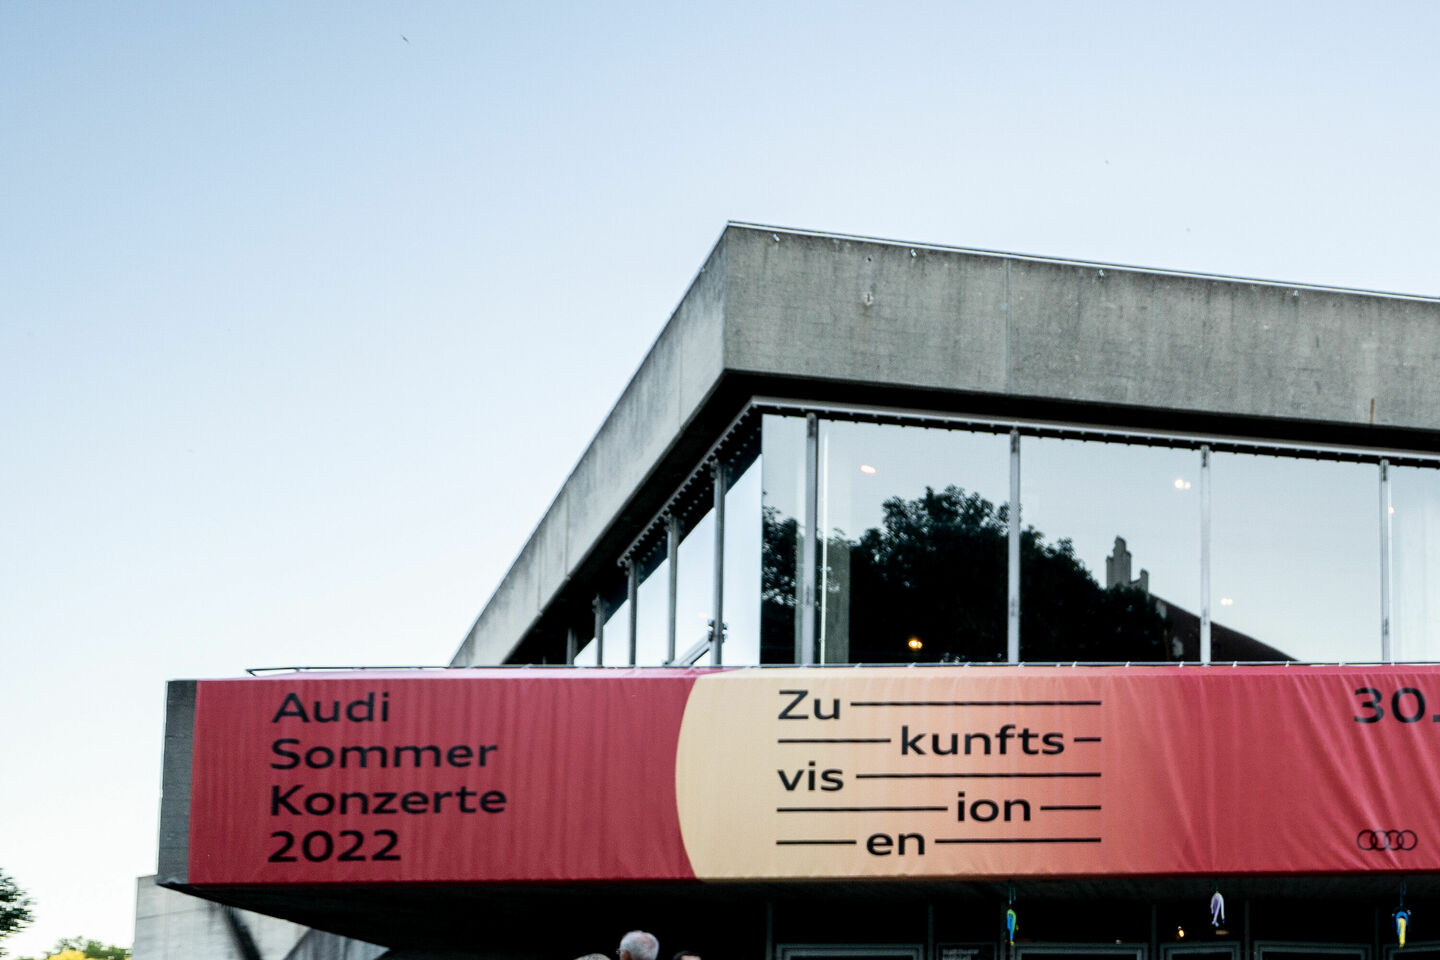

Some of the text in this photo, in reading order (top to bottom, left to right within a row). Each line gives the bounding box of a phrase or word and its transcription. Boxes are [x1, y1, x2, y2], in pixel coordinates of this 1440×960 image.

[272, 692, 389, 724] Audi
[778, 689, 841, 721] Zu
[271, 738, 497, 770] Sommer
[900, 724, 1065, 756] kunfts
[777, 761, 844, 792] vis
[270, 784, 507, 816] Konzerte
[956, 791, 1032, 823] ion
[267, 829, 402, 862] 2022
[865, 831, 925, 856] en
